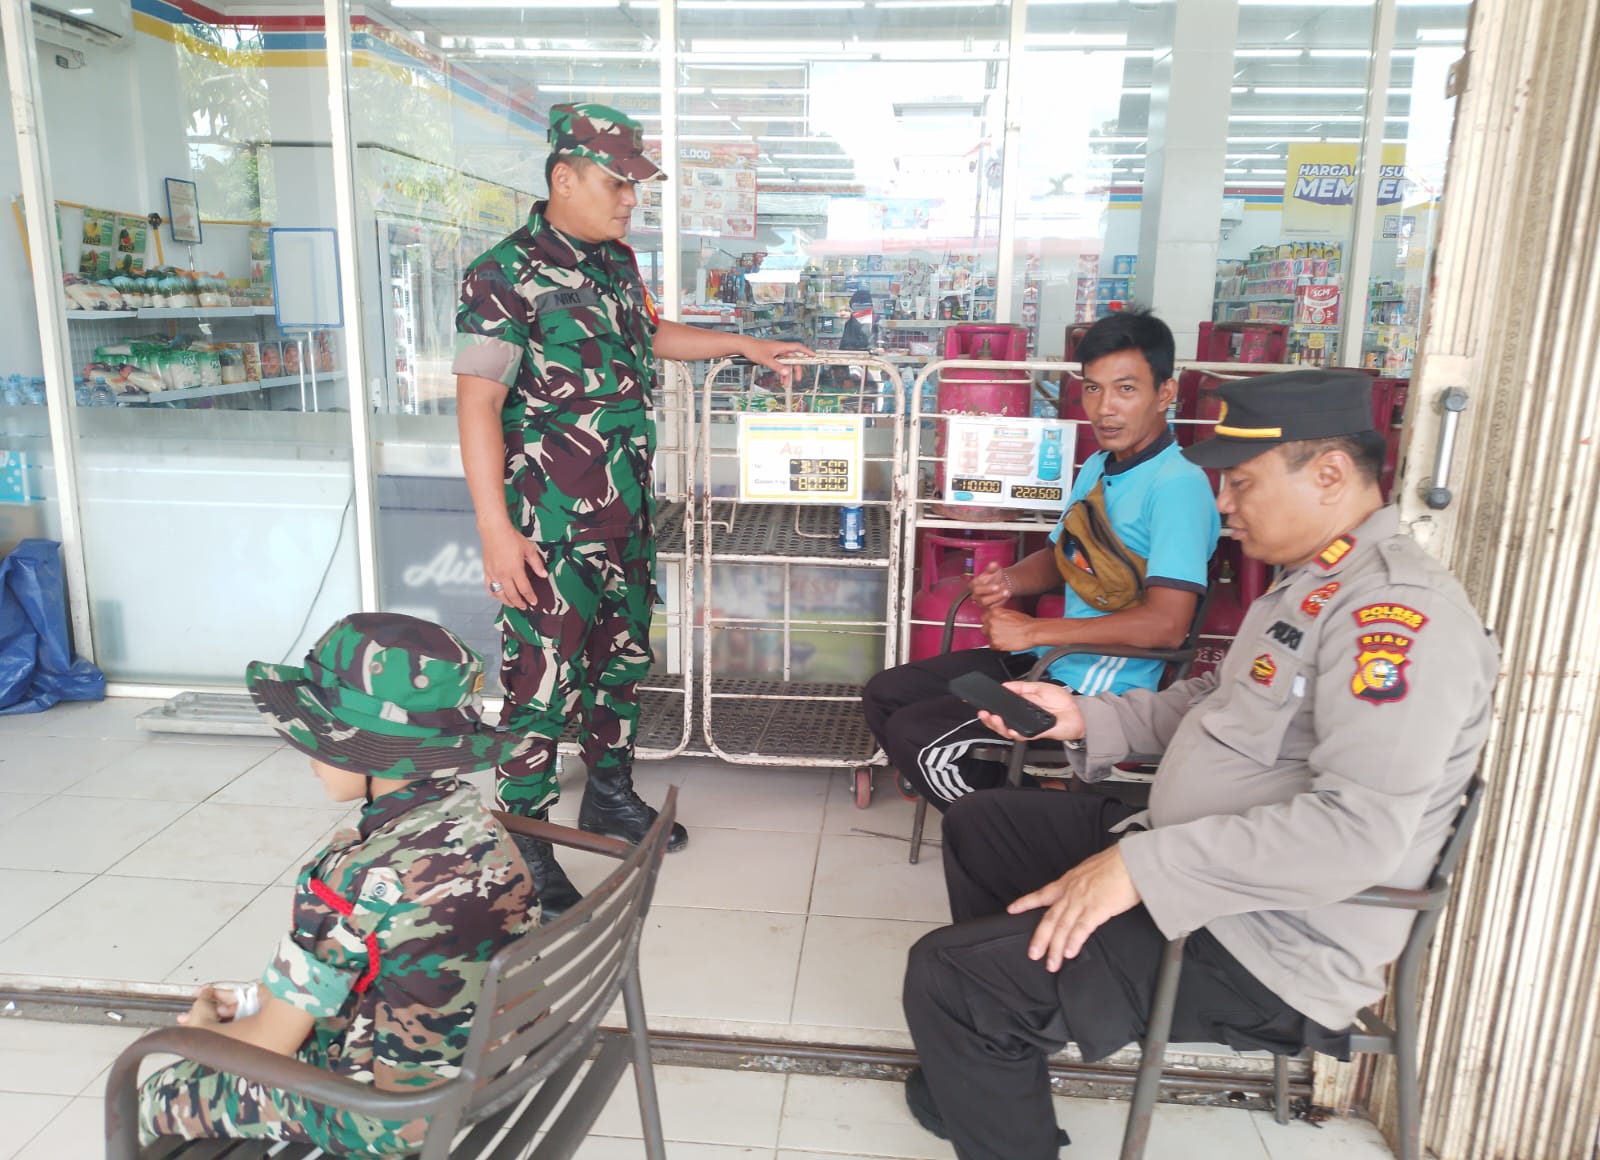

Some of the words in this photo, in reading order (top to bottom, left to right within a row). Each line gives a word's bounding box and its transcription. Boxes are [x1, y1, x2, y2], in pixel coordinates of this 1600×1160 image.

[1299, 164, 1351, 177] HARGA
[553, 292, 582, 306] NIKI
[1359, 606, 1423, 628] POLRES
[1362, 635, 1408, 647] RIAU
